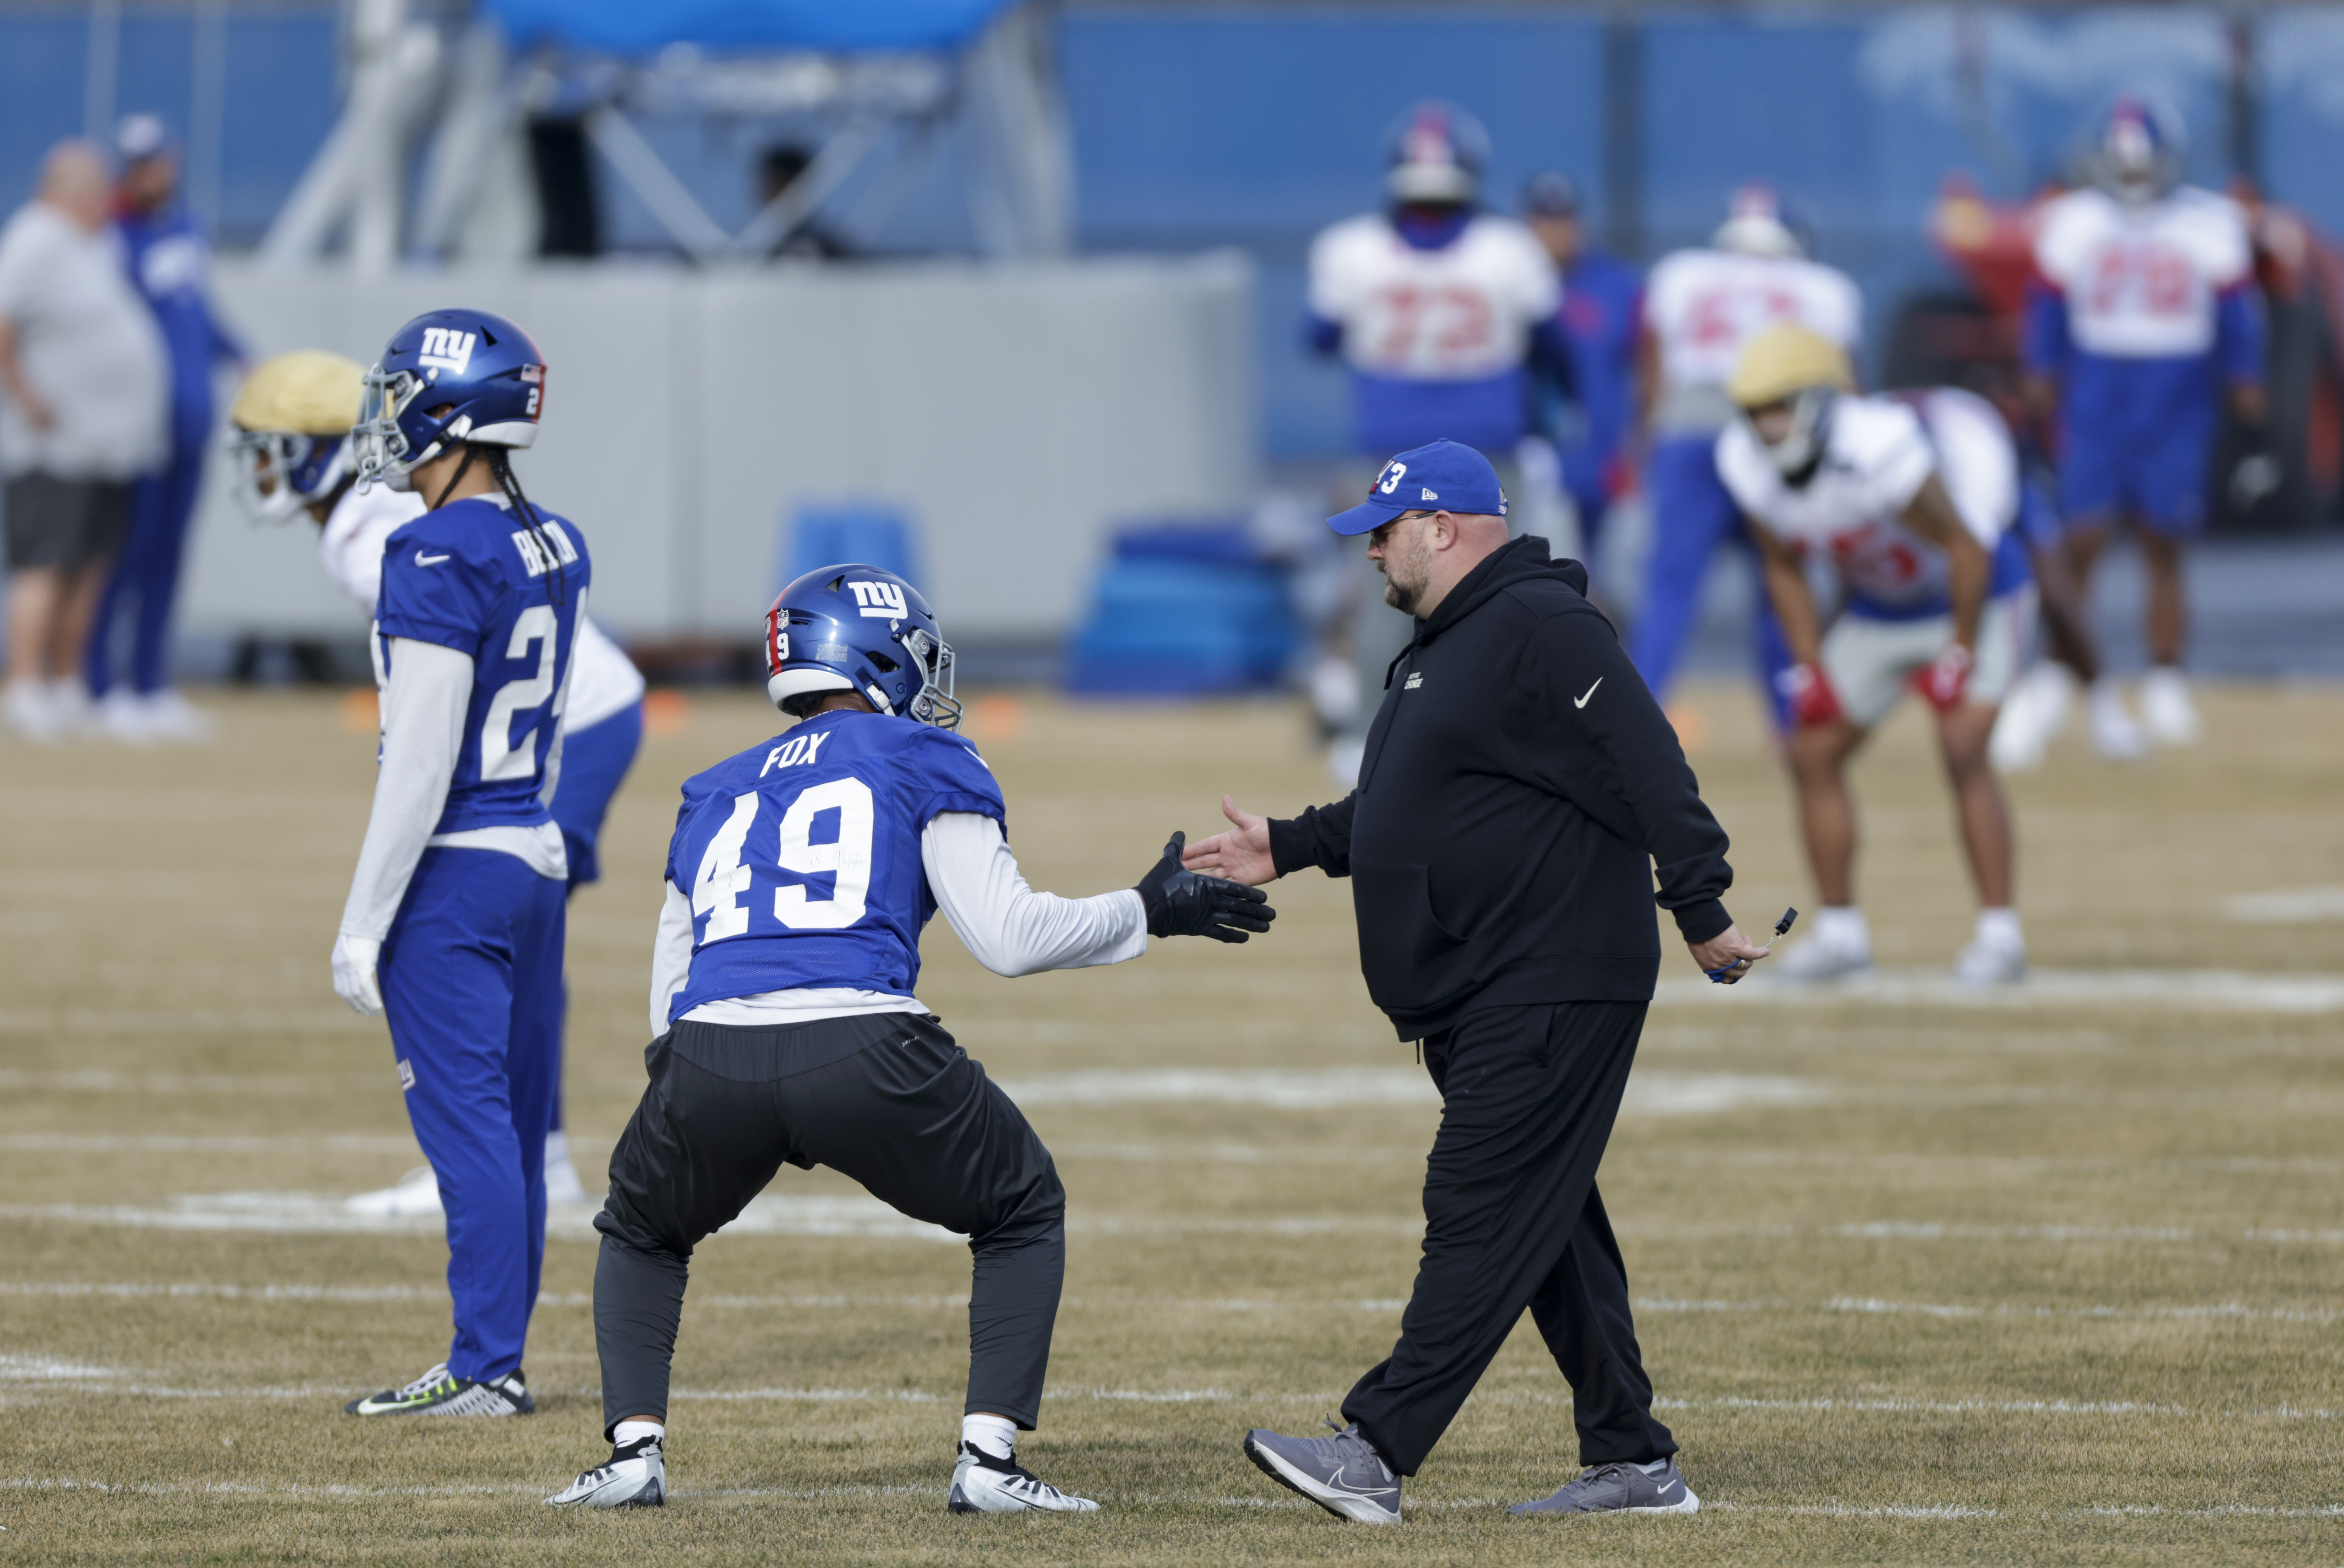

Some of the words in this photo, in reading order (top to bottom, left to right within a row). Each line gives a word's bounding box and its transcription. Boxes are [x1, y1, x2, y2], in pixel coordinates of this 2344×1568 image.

[418, 327, 477, 374] ny
[1381, 462, 1407, 494] 3
[848, 581, 908, 619] ny
[779, 617, 787, 626] NFL
[1404, 678, 1424, 690] CHANGE
[759, 731, 830, 778] FOX
[692, 777, 874, 946] 49
